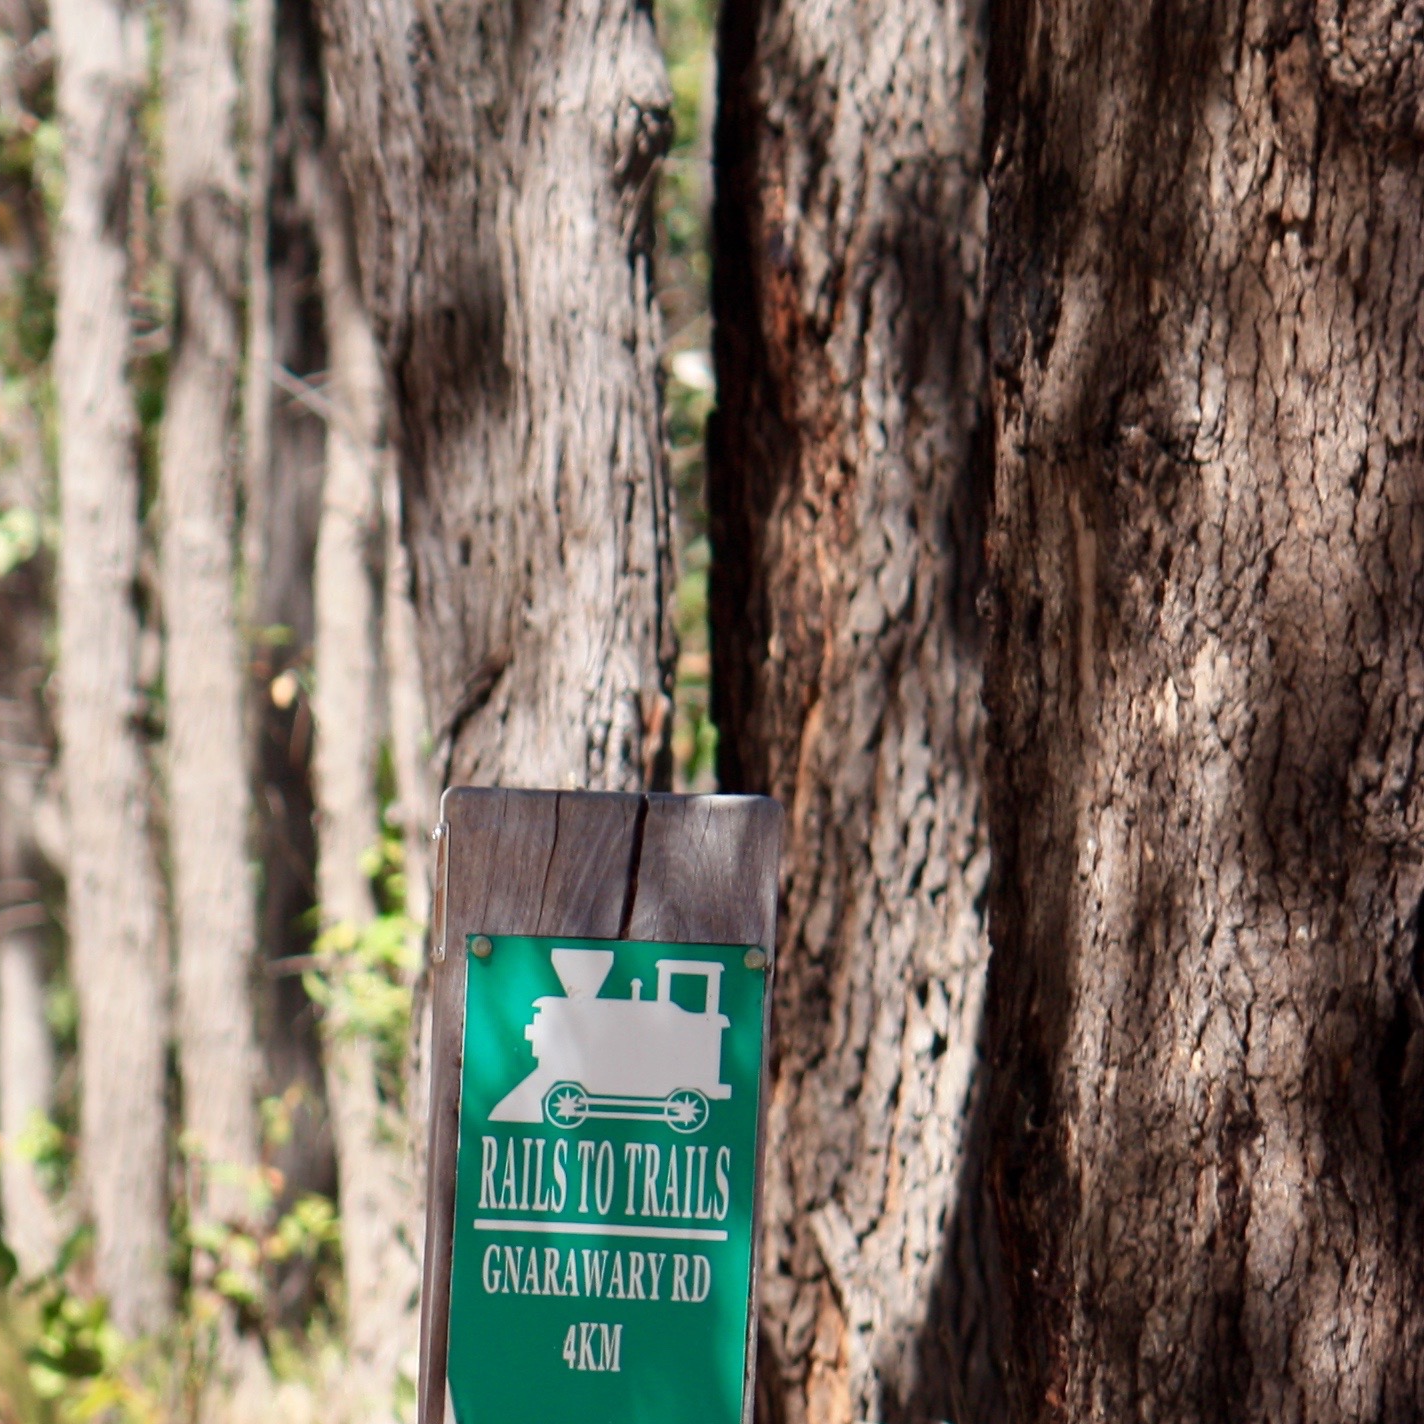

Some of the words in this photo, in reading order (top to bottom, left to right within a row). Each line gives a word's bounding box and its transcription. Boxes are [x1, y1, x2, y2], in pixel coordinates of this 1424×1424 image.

[478, 1136, 568, 1213] RAILS
[578, 1141, 613, 1214] TO
[625, 1143, 729, 1220] TRAILS
[483, 1244, 666, 1299] GNARAWARY
[671, 1254, 711, 1303] RD
[563, 1322, 623, 1372] 4KM
